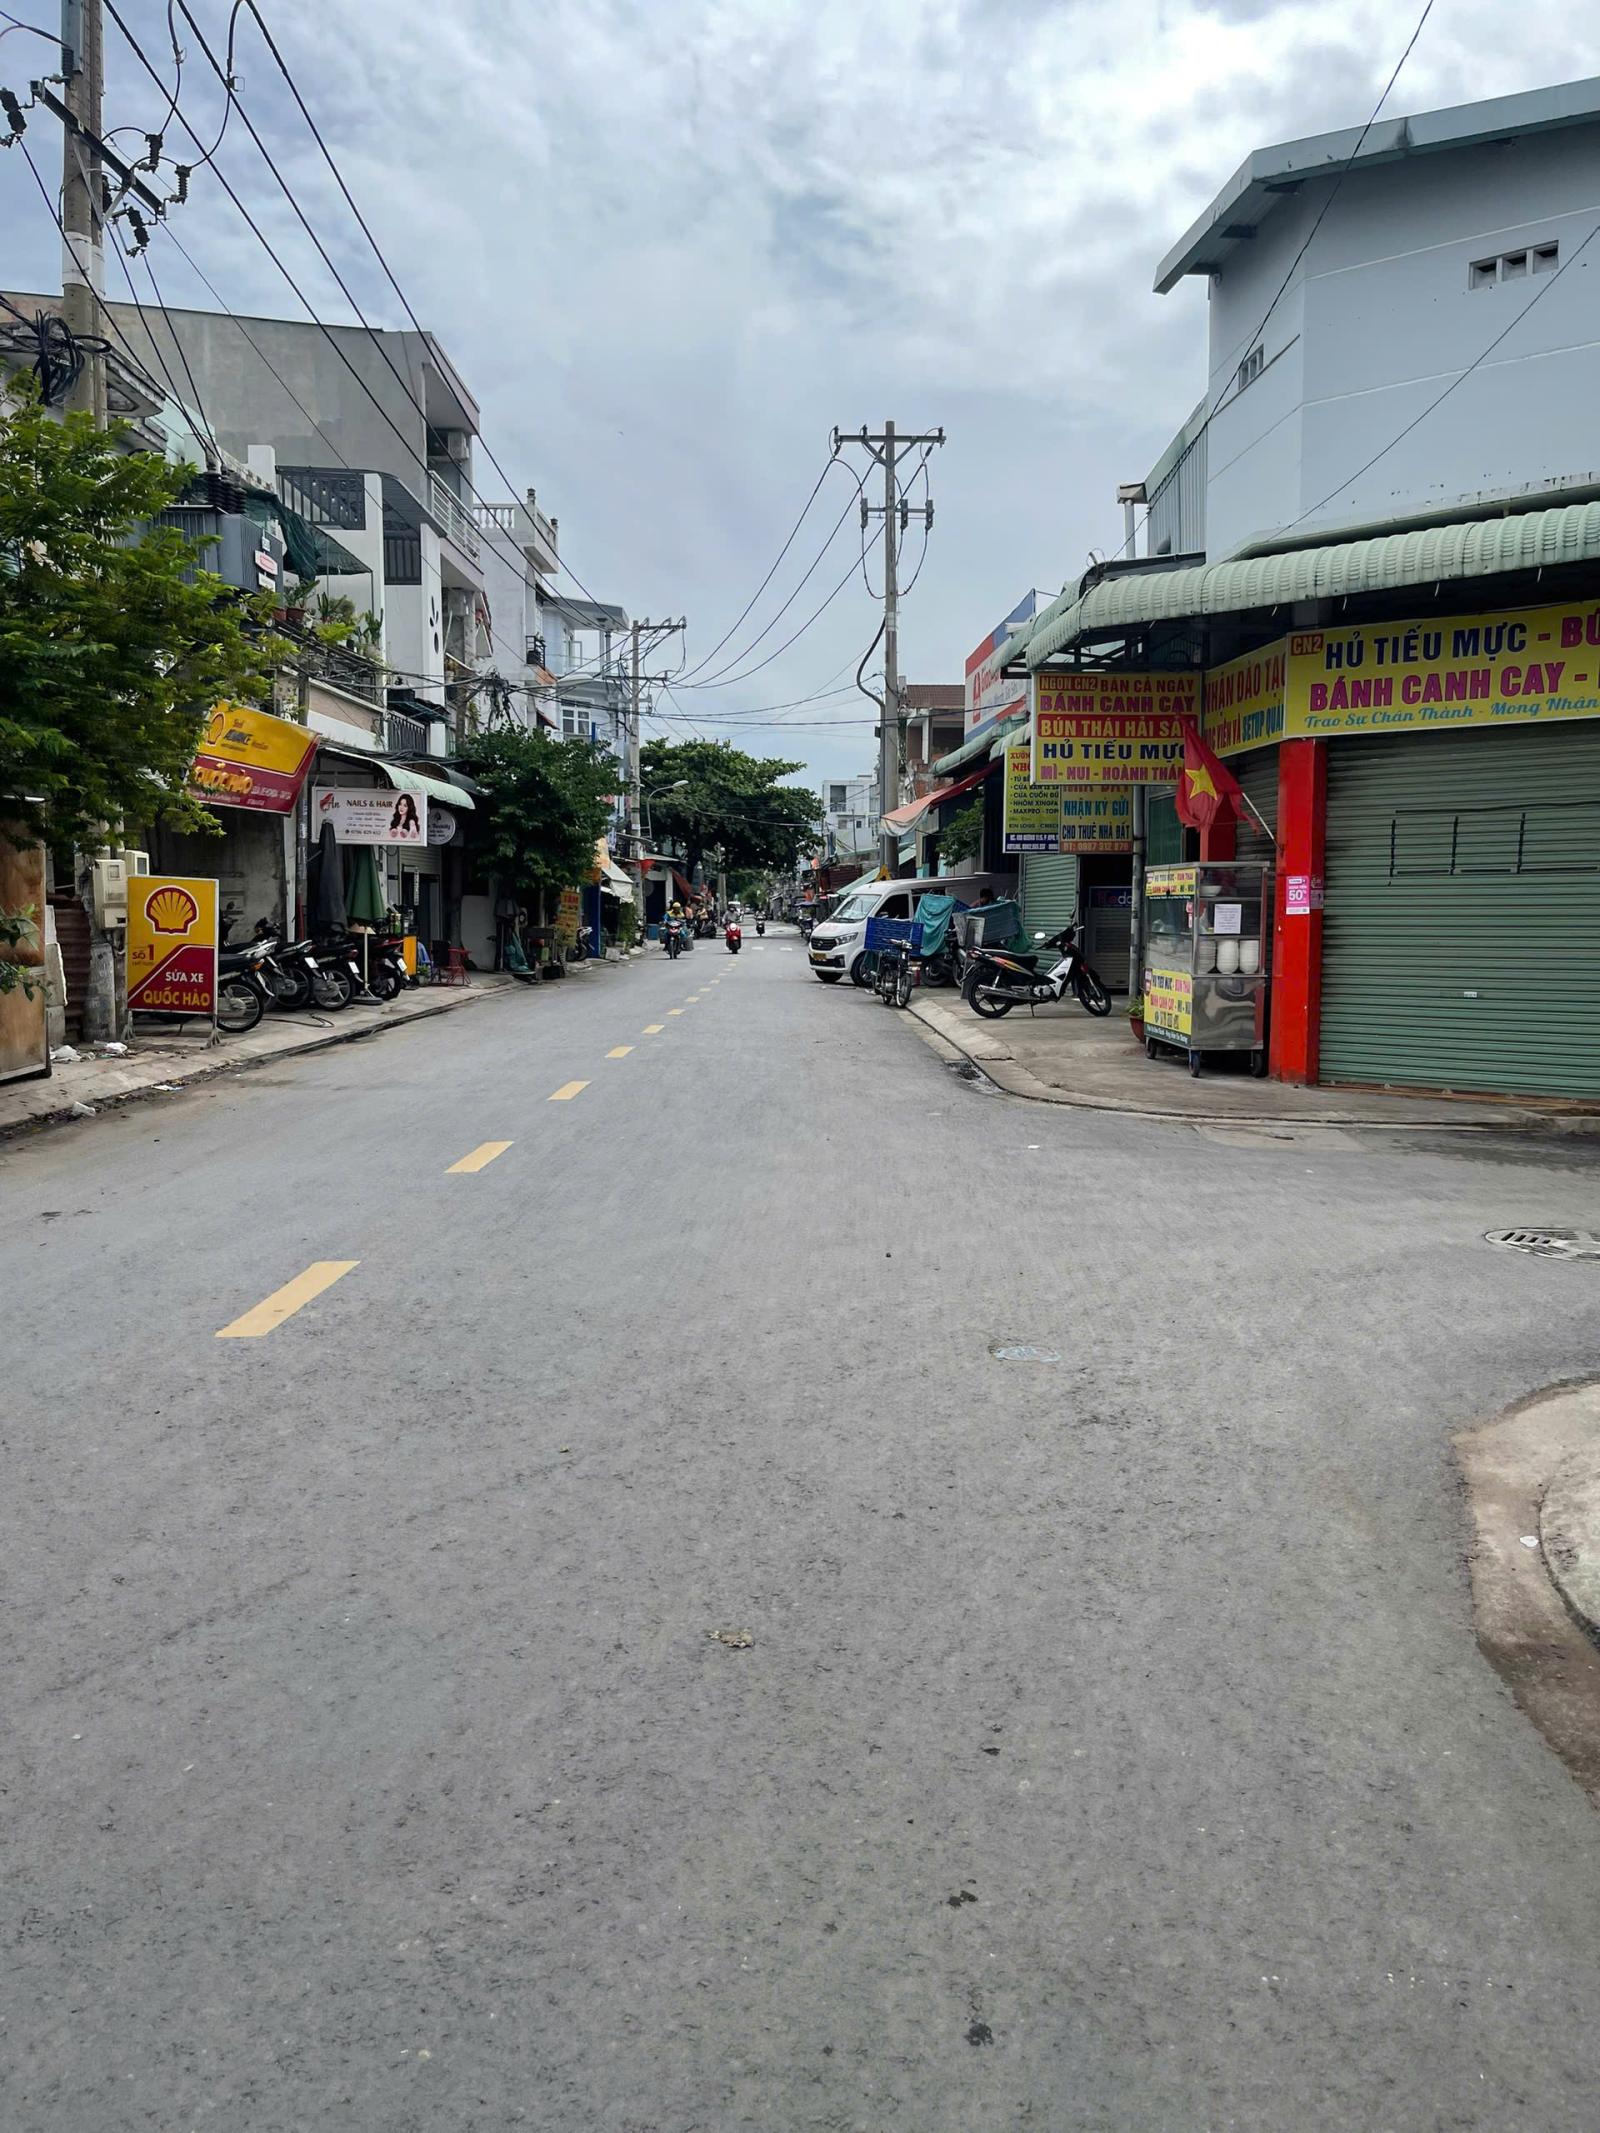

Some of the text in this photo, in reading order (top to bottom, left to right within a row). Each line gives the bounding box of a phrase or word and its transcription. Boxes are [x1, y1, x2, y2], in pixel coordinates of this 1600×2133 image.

[1293, 636, 1323, 654] CN2
[1326, 631, 1364, 670] HỦ
[1374, 624, 1442, 665] TIẾU
[1453, 622, 1527, 661] MỰC
[1075, 677, 1097, 690] CN2
[1310, 676, 1393, 711] BÁNH
[1402, 669, 1491, 704] CANH
[1500, 661, 1566, 697] CAY
[1040, 692, 1095, 712] BÁNH
[1100, 696, 1153, 713] CANH
[1158, 696, 1195, 713] CAY
[1305, 715, 1340, 728] Trao
[1372, 709, 1415, 724] Chân
[1418, 705, 1474, 721] Thành
[1491, 702, 1541, 717] Mong
[1041, 716, 1077, 736] BÚN
[1081, 717, 1120, 737] THÁI
[1125, 716, 1154, 737] HẢI
[1242, 710, 1265, 742] SETUP
[1043, 739, 1074, 759] HỦ
[1081, 739, 1132, 760] TIẾU
[345, 799, 393, 808] NAILS & HAIR
[1063, 798, 1092, 819] NHẬN
[1062, 824, 1076, 839] CHO
[148, 944, 155, 961] 1
[165, 969, 204, 983] SỬA XE
[143, 986, 180, 1005] QUỐC
